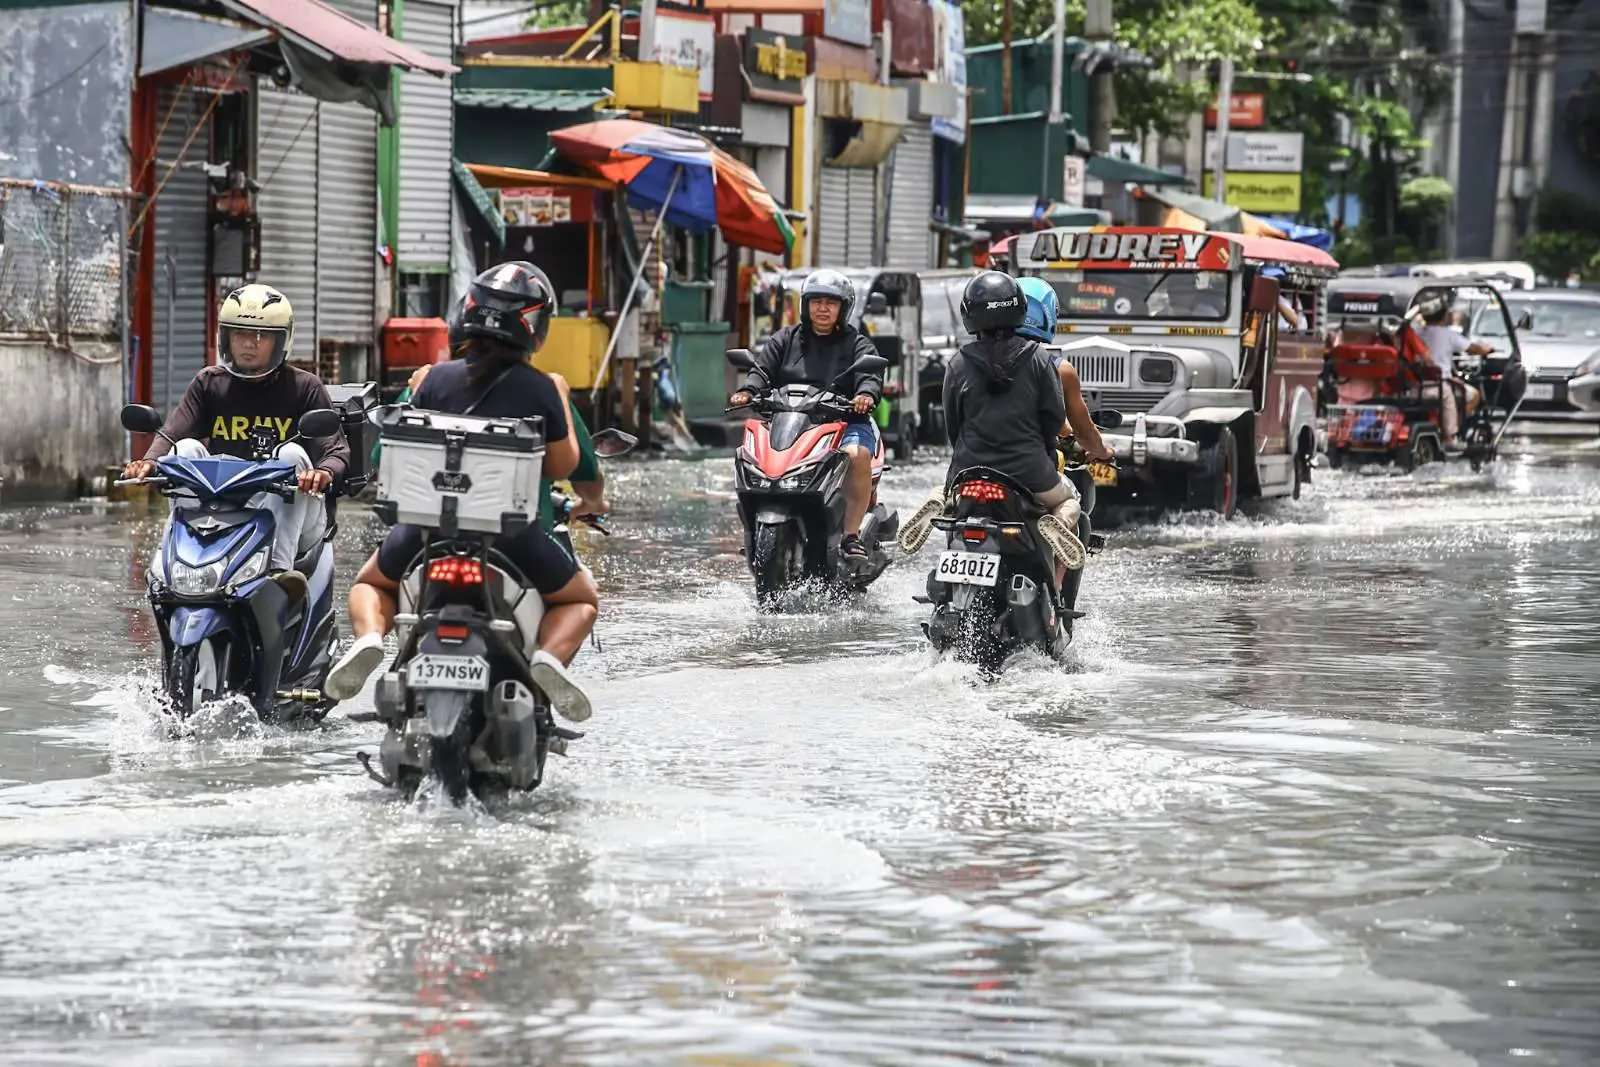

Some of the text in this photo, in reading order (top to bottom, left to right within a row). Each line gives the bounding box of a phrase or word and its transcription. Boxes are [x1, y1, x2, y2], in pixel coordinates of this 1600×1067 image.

[1030, 232, 1210, 261] AUDREY
[1344, 302, 1378, 312] PRIVATE
[940, 558, 996, 578] 681QIZ
[416, 664, 483, 680] 137NSW
